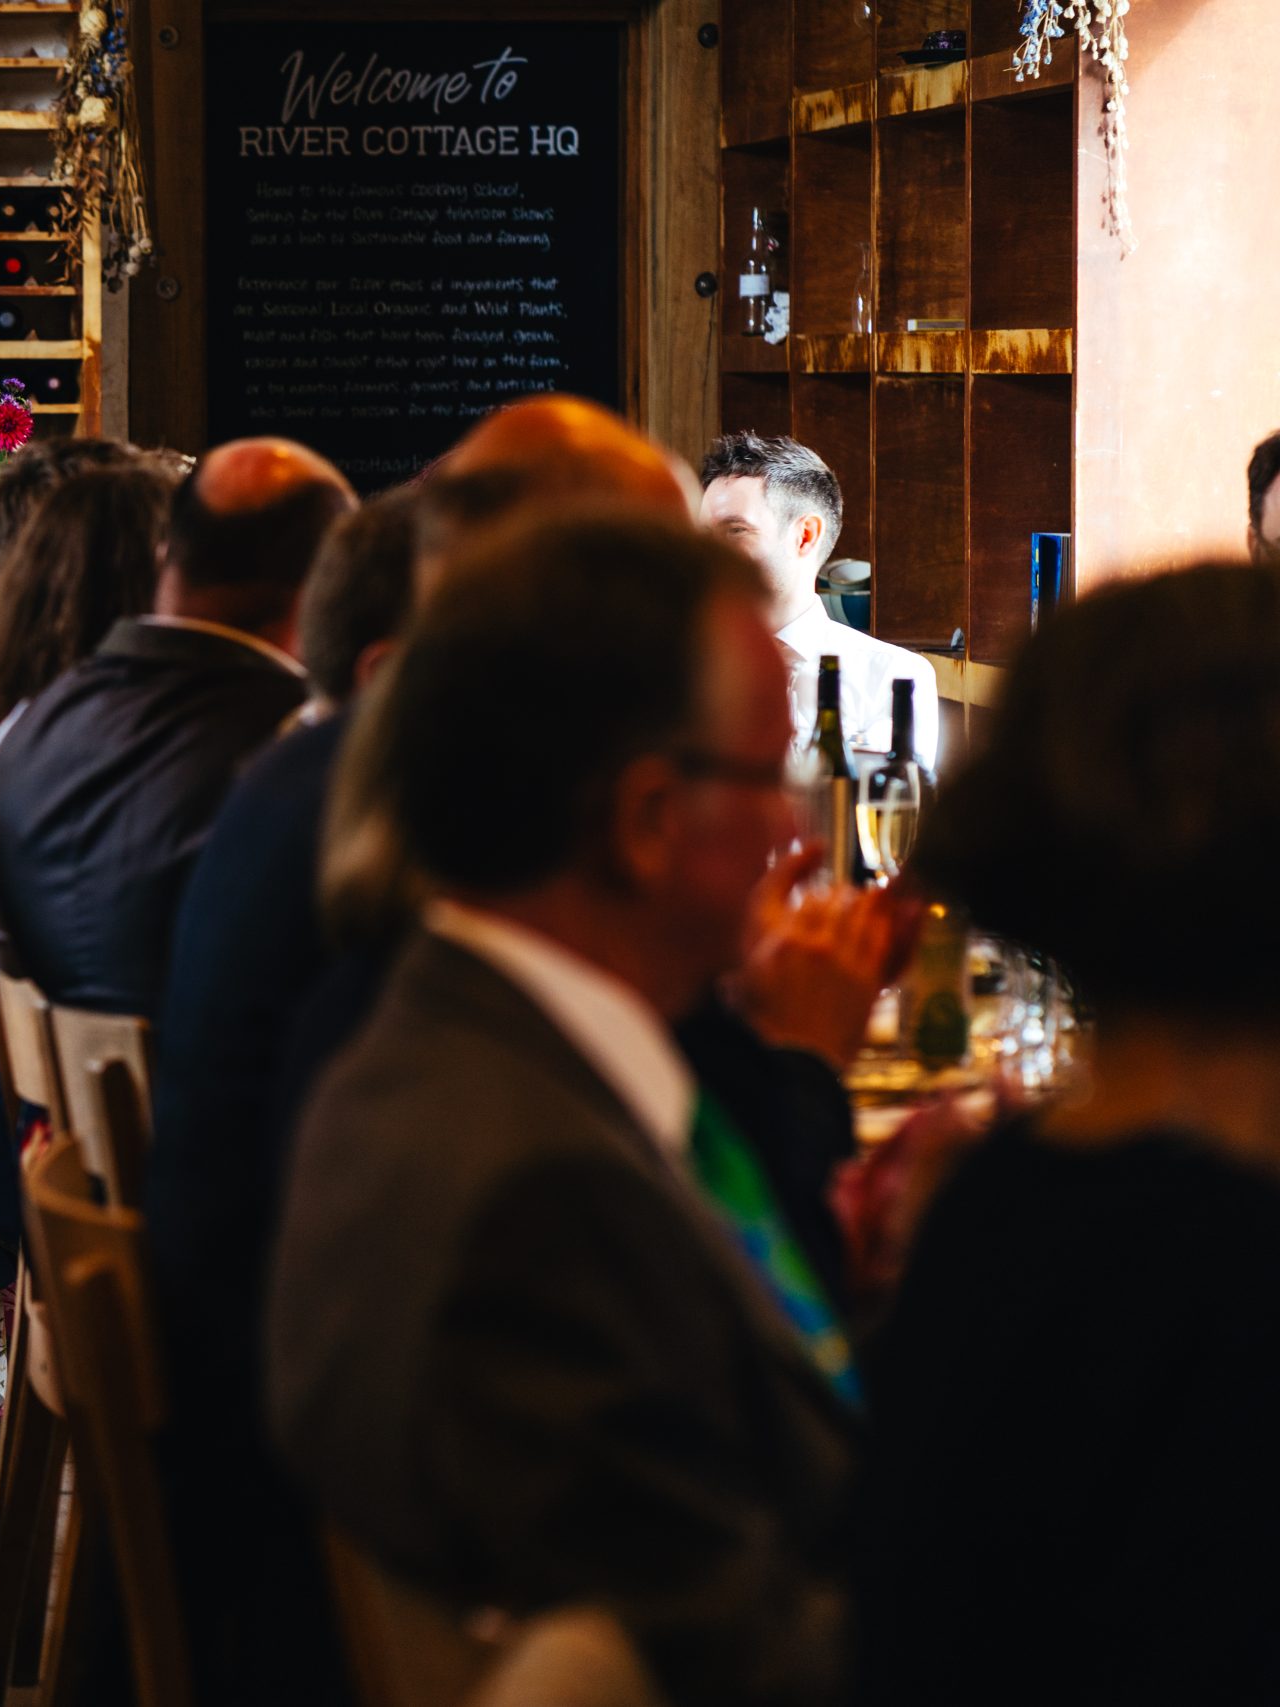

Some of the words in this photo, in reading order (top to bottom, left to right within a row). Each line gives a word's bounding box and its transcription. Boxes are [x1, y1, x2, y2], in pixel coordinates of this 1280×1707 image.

[279, 49, 472, 124] Welcome
[472, 45, 528, 104] to
[238, 126, 351, 157] RIVER
[362, 125, 519, 157] COTTAGE
[529, 125, 580, 157] HQ
[317, 182, 345, 199] the
[445, 205, 507, 222] television
[432, 229, 462, 247] food
[467, 232, 492, 246] and
[496, 230, 552, 252] farming
[450, 278, 525, 297] ingredients
[529, 277, 560, 292] that
[440, 302, 468, 316] and
[451, 353, 479, 369] here
[501, 353, 526, 369] the
[466, 379, 492, 393] and
[495, 378, 555, 393] artisans
